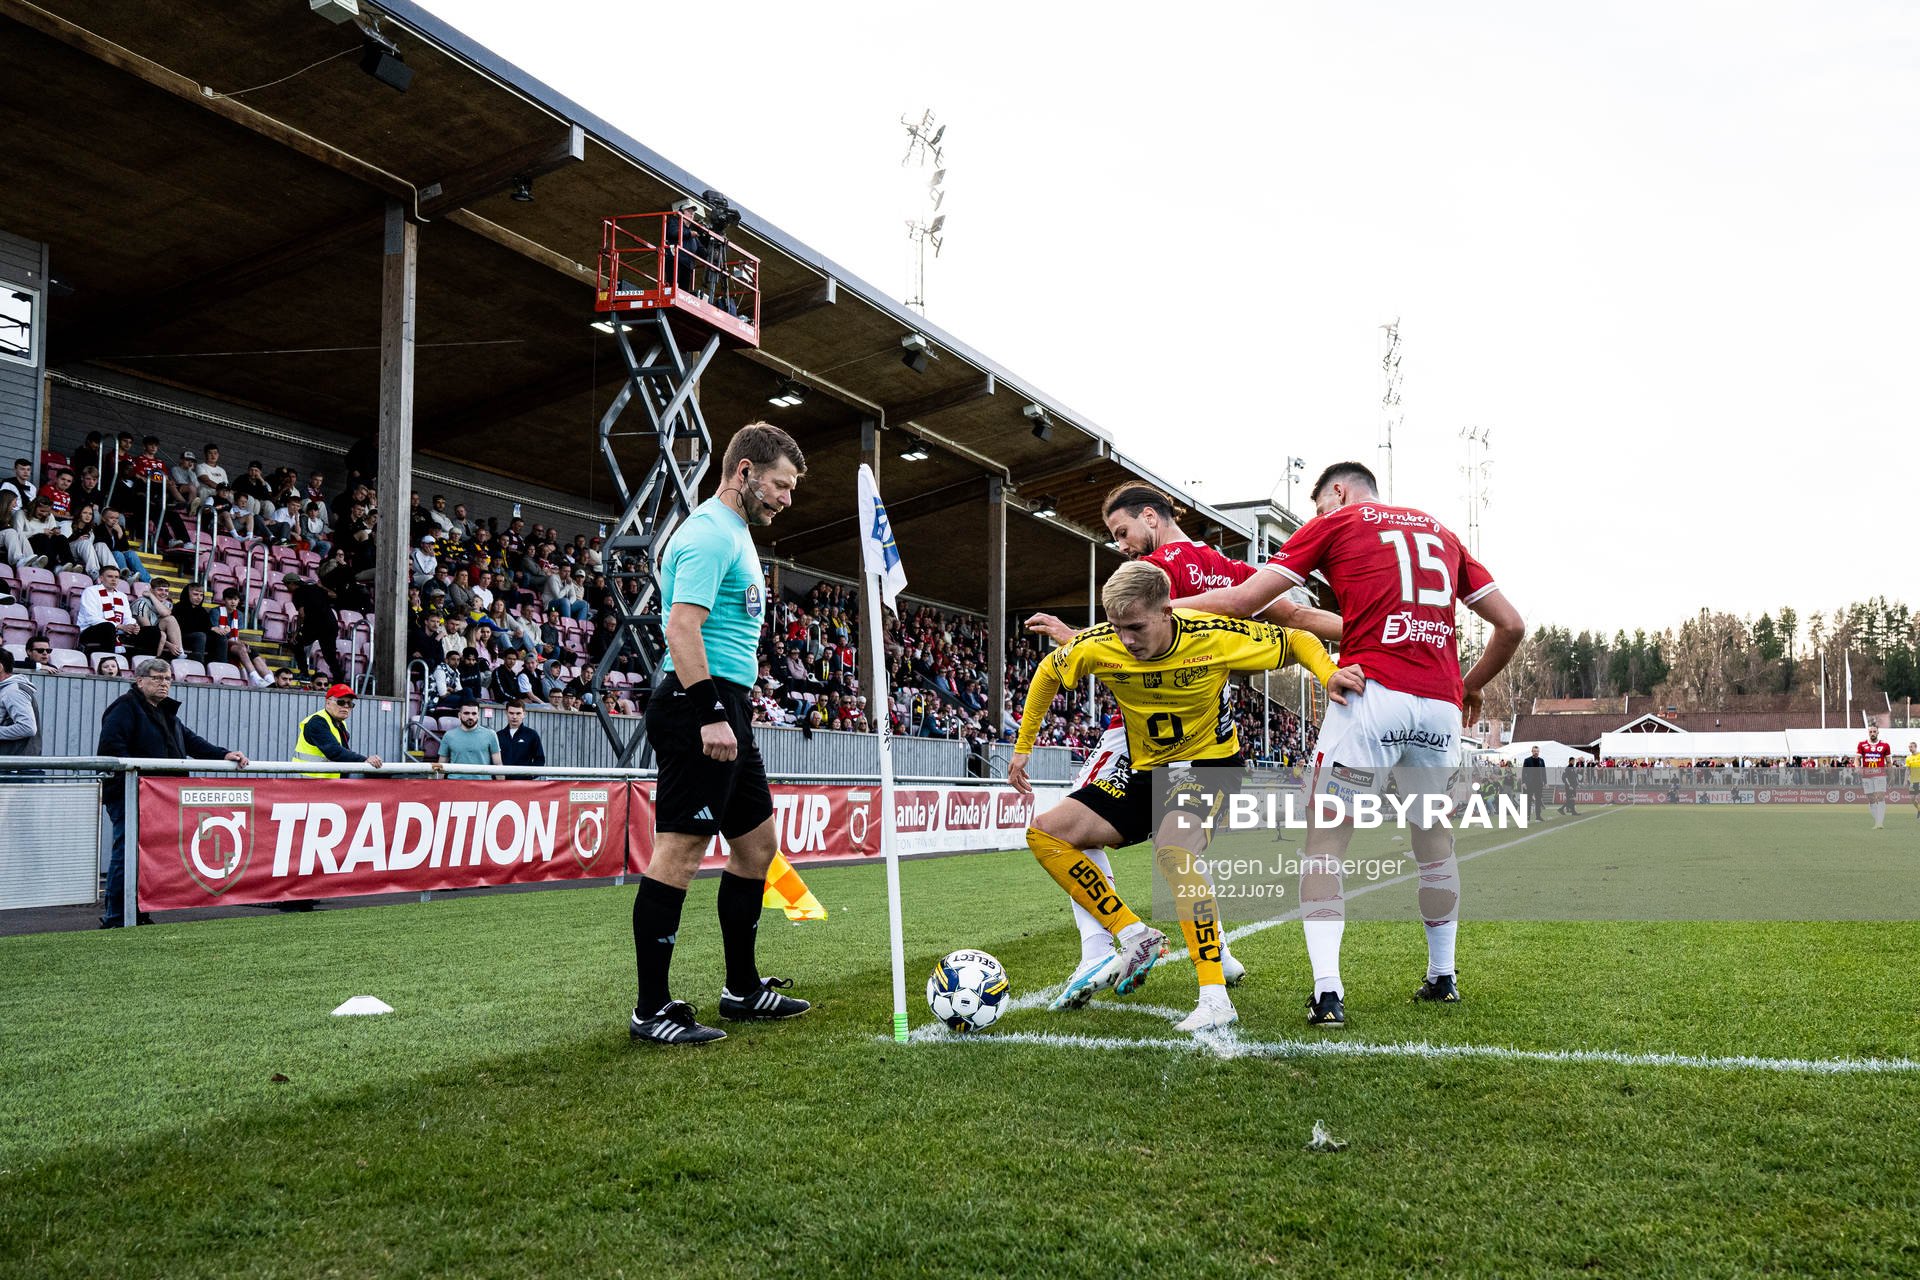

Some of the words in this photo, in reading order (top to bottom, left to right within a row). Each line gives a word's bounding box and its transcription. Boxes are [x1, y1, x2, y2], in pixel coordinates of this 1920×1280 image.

[1378, 529, 1453, 609] 15
[1183, 654, 1213, 665] PULSEN
[883, 712, 891, 752] LISKI
[184, 792, 249, 802] DEGERFORS
[571, 792, 606, 800] DEGERFORS
[1558, 792, 1594, 802] TRITION
[896, 797, 926, 827] anda
[270, 800, 559, 877] TRADITION
[953, 953, 997, 970] SELECT
